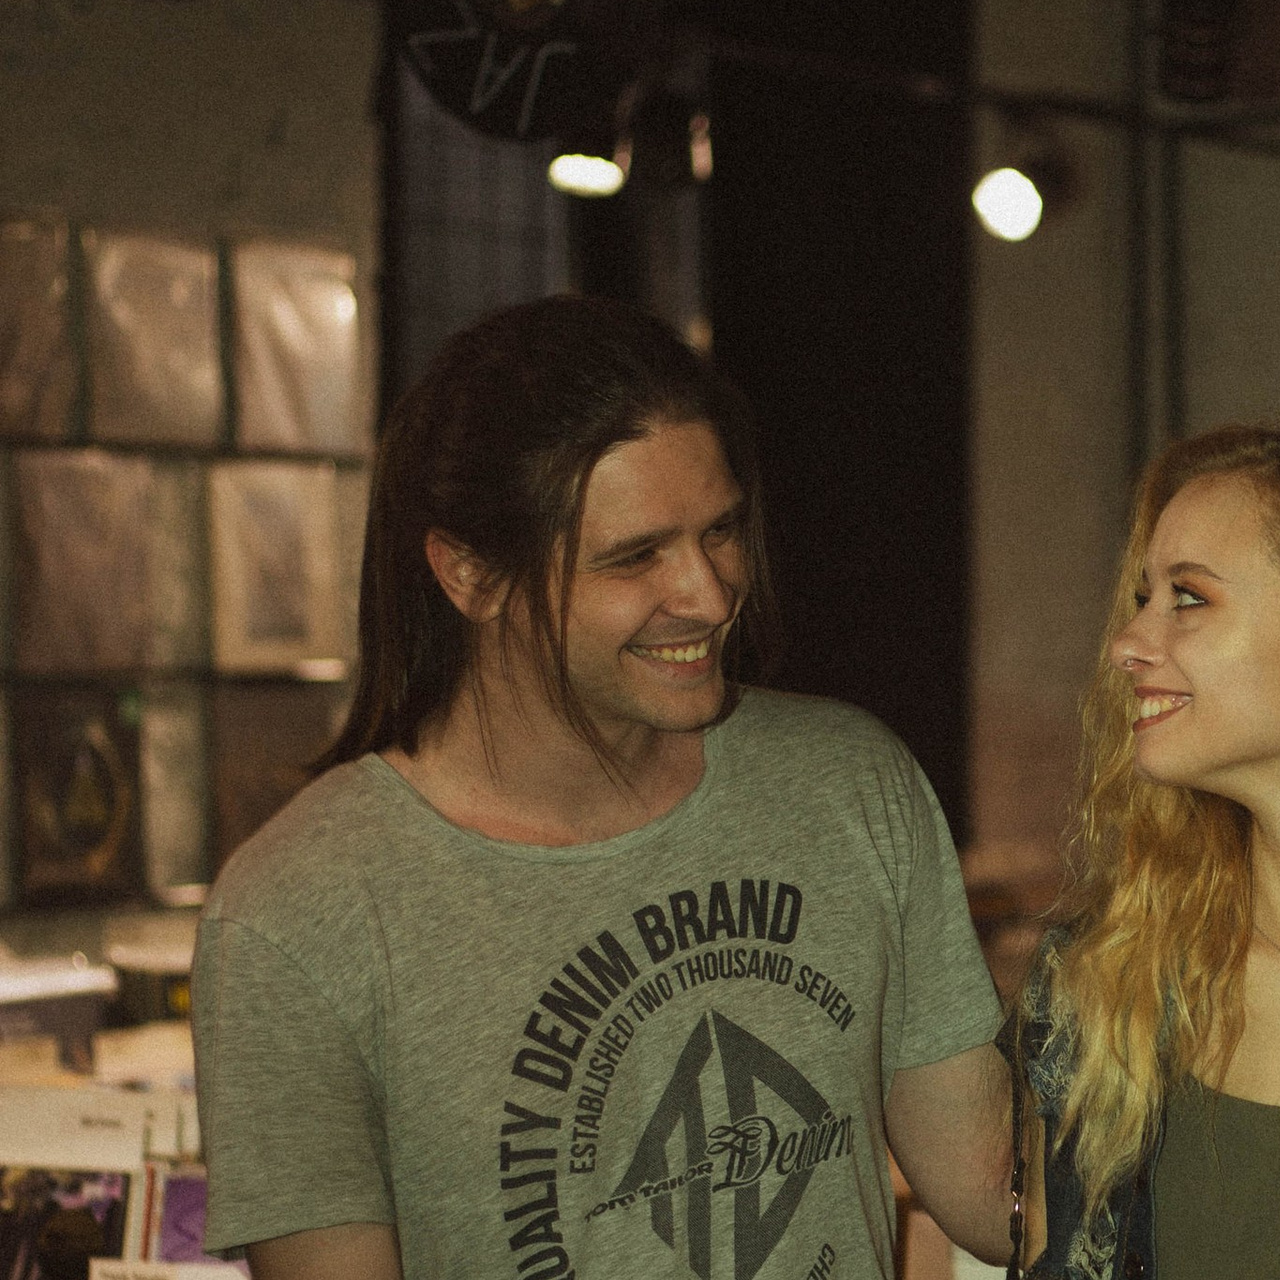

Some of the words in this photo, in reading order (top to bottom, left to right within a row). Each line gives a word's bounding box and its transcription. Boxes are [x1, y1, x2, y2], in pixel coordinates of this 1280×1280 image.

[511, 929, 641, 1093] DENIM
[632, 878, 804, 966] BRAND
[569, 1013, 636, 1174] ESTABLISHED
[624, 971, 675, 1024] TWO
[672, 947, 793, 991] THOUSAND
[794, 965, 857, 1033] SEVEN
